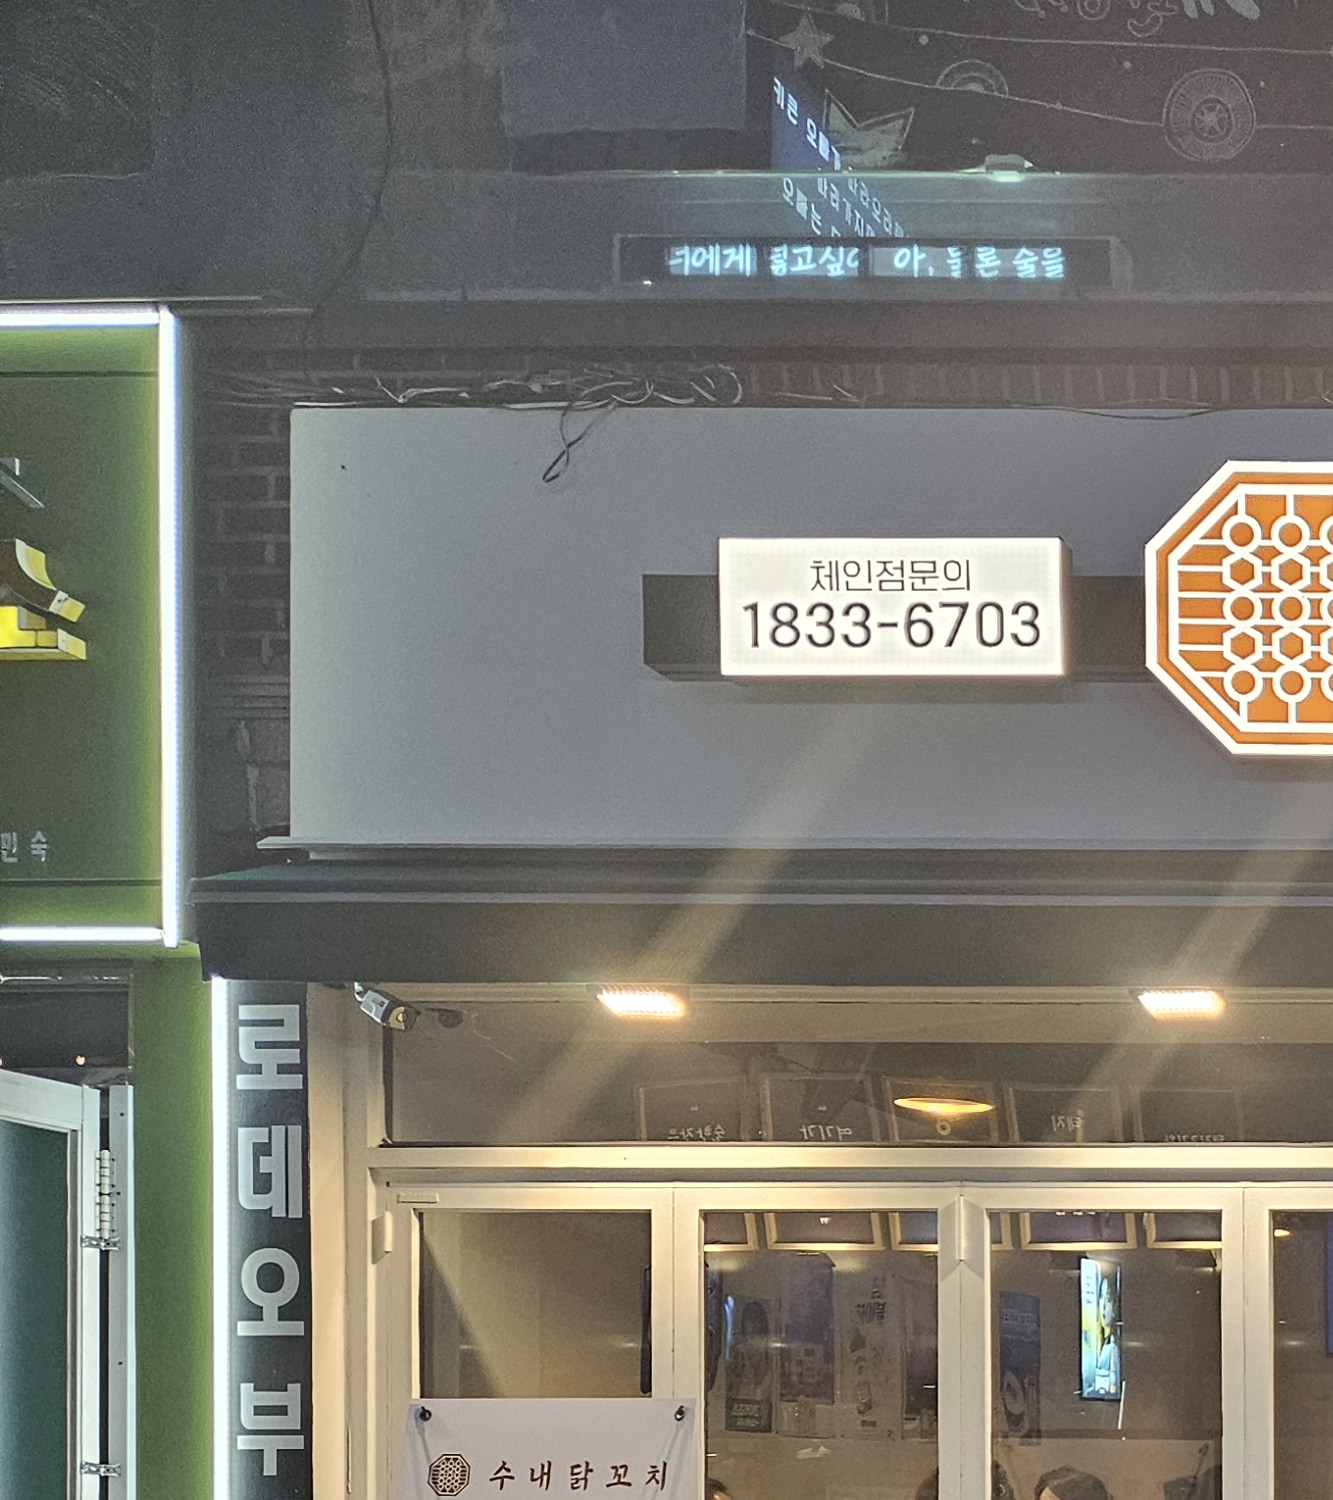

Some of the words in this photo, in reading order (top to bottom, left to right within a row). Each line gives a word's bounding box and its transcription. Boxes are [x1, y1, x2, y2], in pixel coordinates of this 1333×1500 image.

[809, 558, 972, 593] 체인점문의
[740, 600, 1043, 649] 1833-6703
[488, 1460, 669, 1492] 수내닭꼬치
